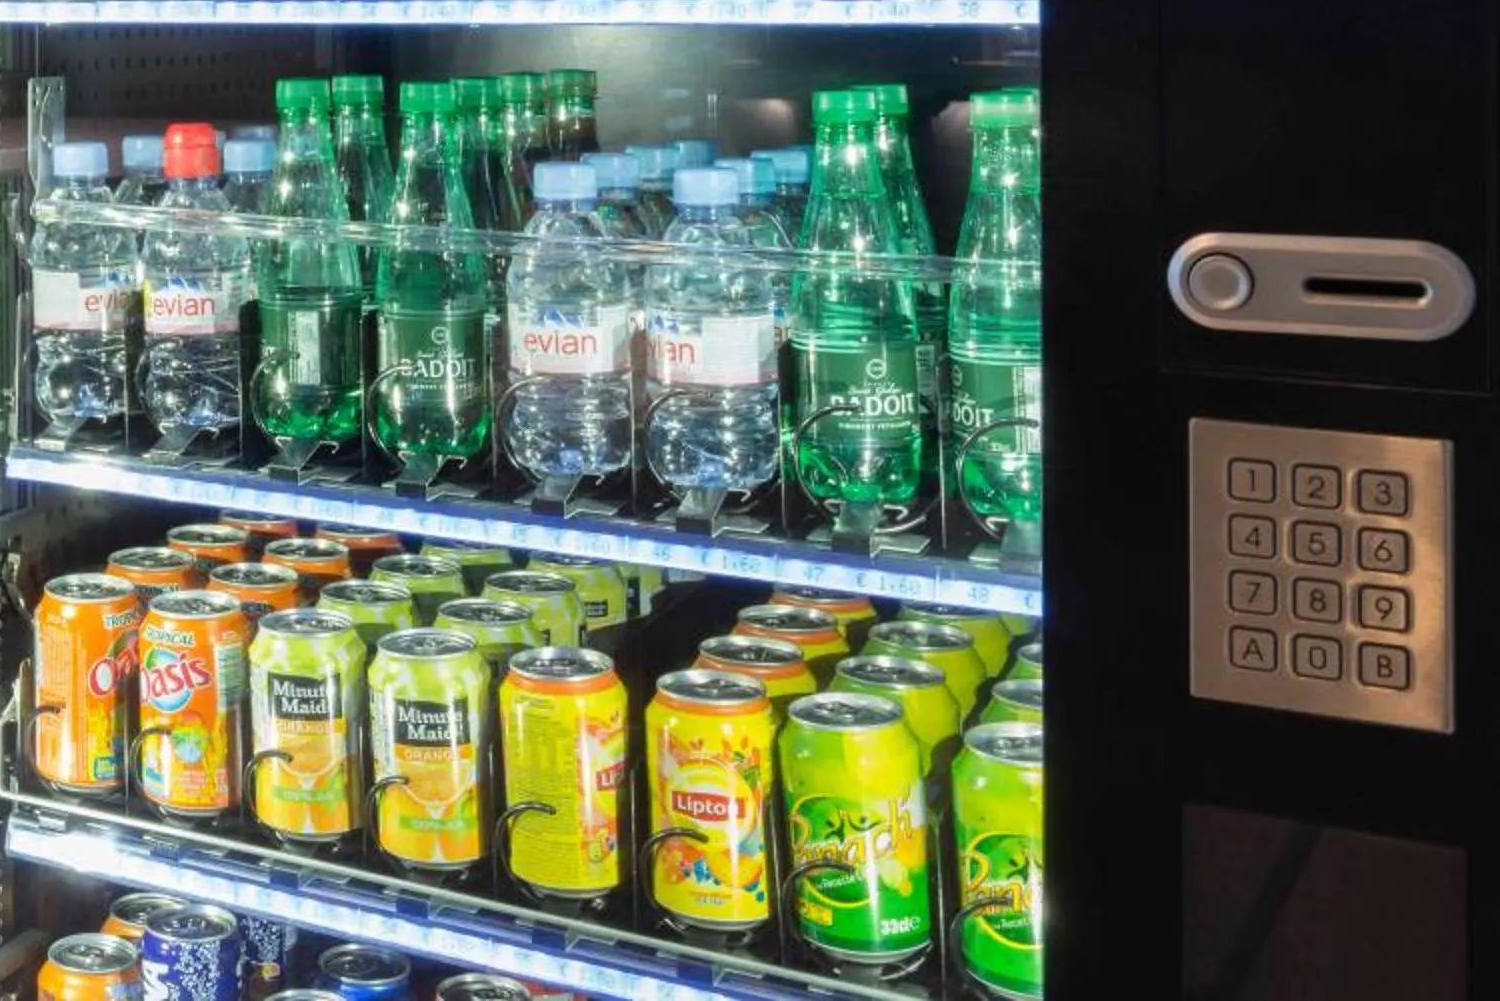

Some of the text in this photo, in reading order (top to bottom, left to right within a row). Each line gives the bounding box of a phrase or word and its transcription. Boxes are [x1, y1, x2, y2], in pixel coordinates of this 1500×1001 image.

[84, 289, 132, 313] evia
[152, 293, 216, 317] evian
[523, 329, 598, 357] evian
[650, 334, 696, 365] vian
[951, 401, 995, 428] DOIT
[1248, 469, 1392, 506] 1 2 3
[1244, 526, 1393, 563] 4 5 6
[1246, 582, 1393, 621] 7 8 9
[1242, 639, 1264, 662] A
[1377, 655, 1394, 678] B
[273, 678, 335, 699] Minut
[281, 697, 330, 715] Maid
[399, 705, 463, 725] Minute
[407, 723, 455, 741] Maid
[676, 794, 741, 818] Lipton
